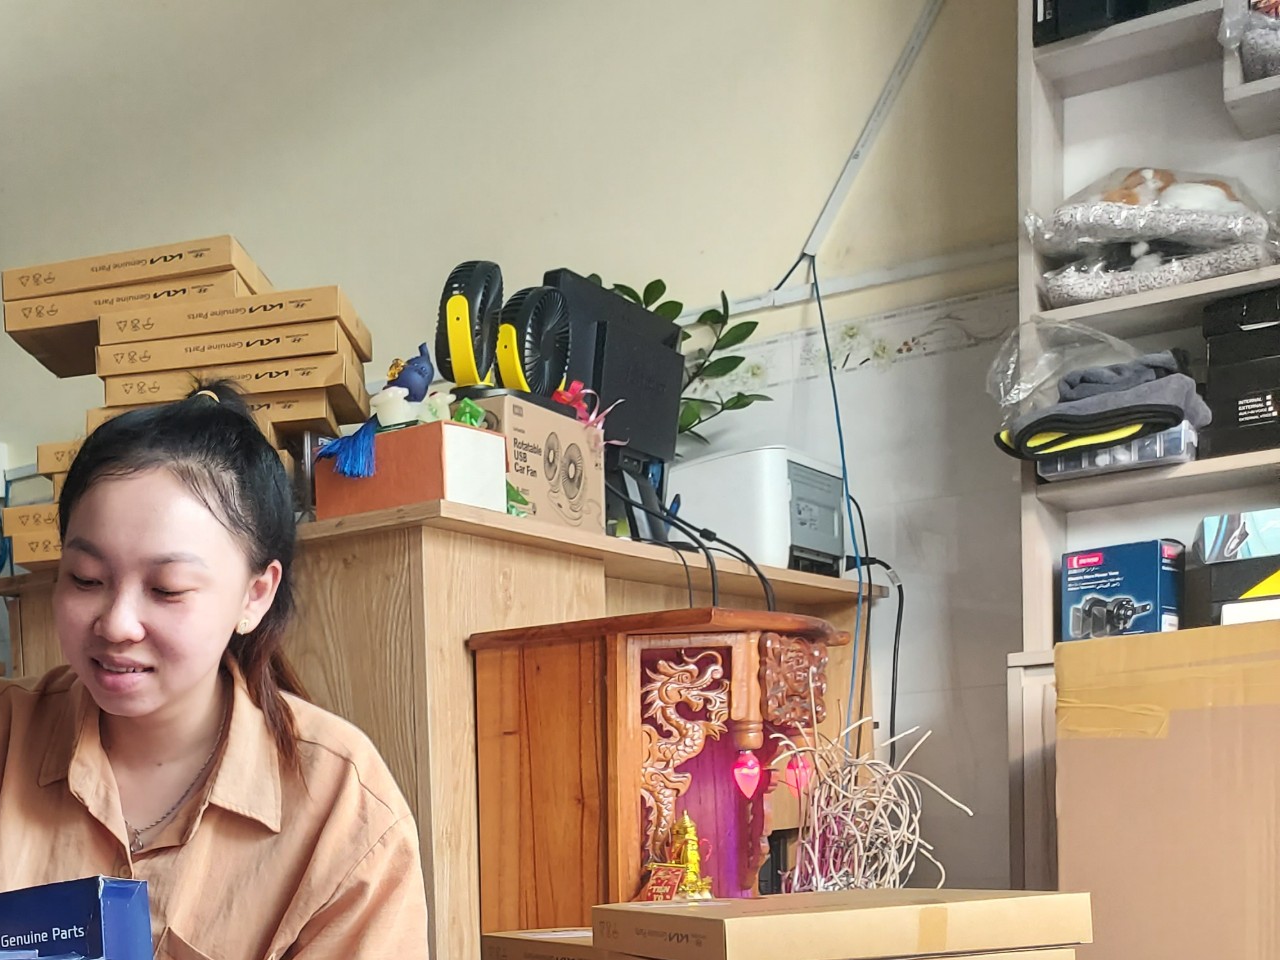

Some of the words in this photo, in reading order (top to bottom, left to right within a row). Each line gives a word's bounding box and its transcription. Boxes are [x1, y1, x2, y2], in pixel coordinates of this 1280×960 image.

[113, 258, 147, 269] Genuine
[149, 252, 183, 265] KIA
[91, 263, 110, 273] Parts
[153, 287, 187, 299] KIA
[210, 307, 246, 318] Genuine
[249, 302, 283, 314] KIA
[187, 311, 209, 320] Parts
[207, 341, 243, 352] Genuine
[246, 337, 280, 348] KIA
[184, 345, 205, 354] Parts
[254, 369, 289, 380] KIA
[513, 438, 542, 457] Rotatable
[514, 450, 528, 463] USB
[514, 463, 526, 474] Car
[527, 465, 538, 478] Fan
[0, 930, 48, 948] Genuine
[52, 924, 85, 942] Parts
